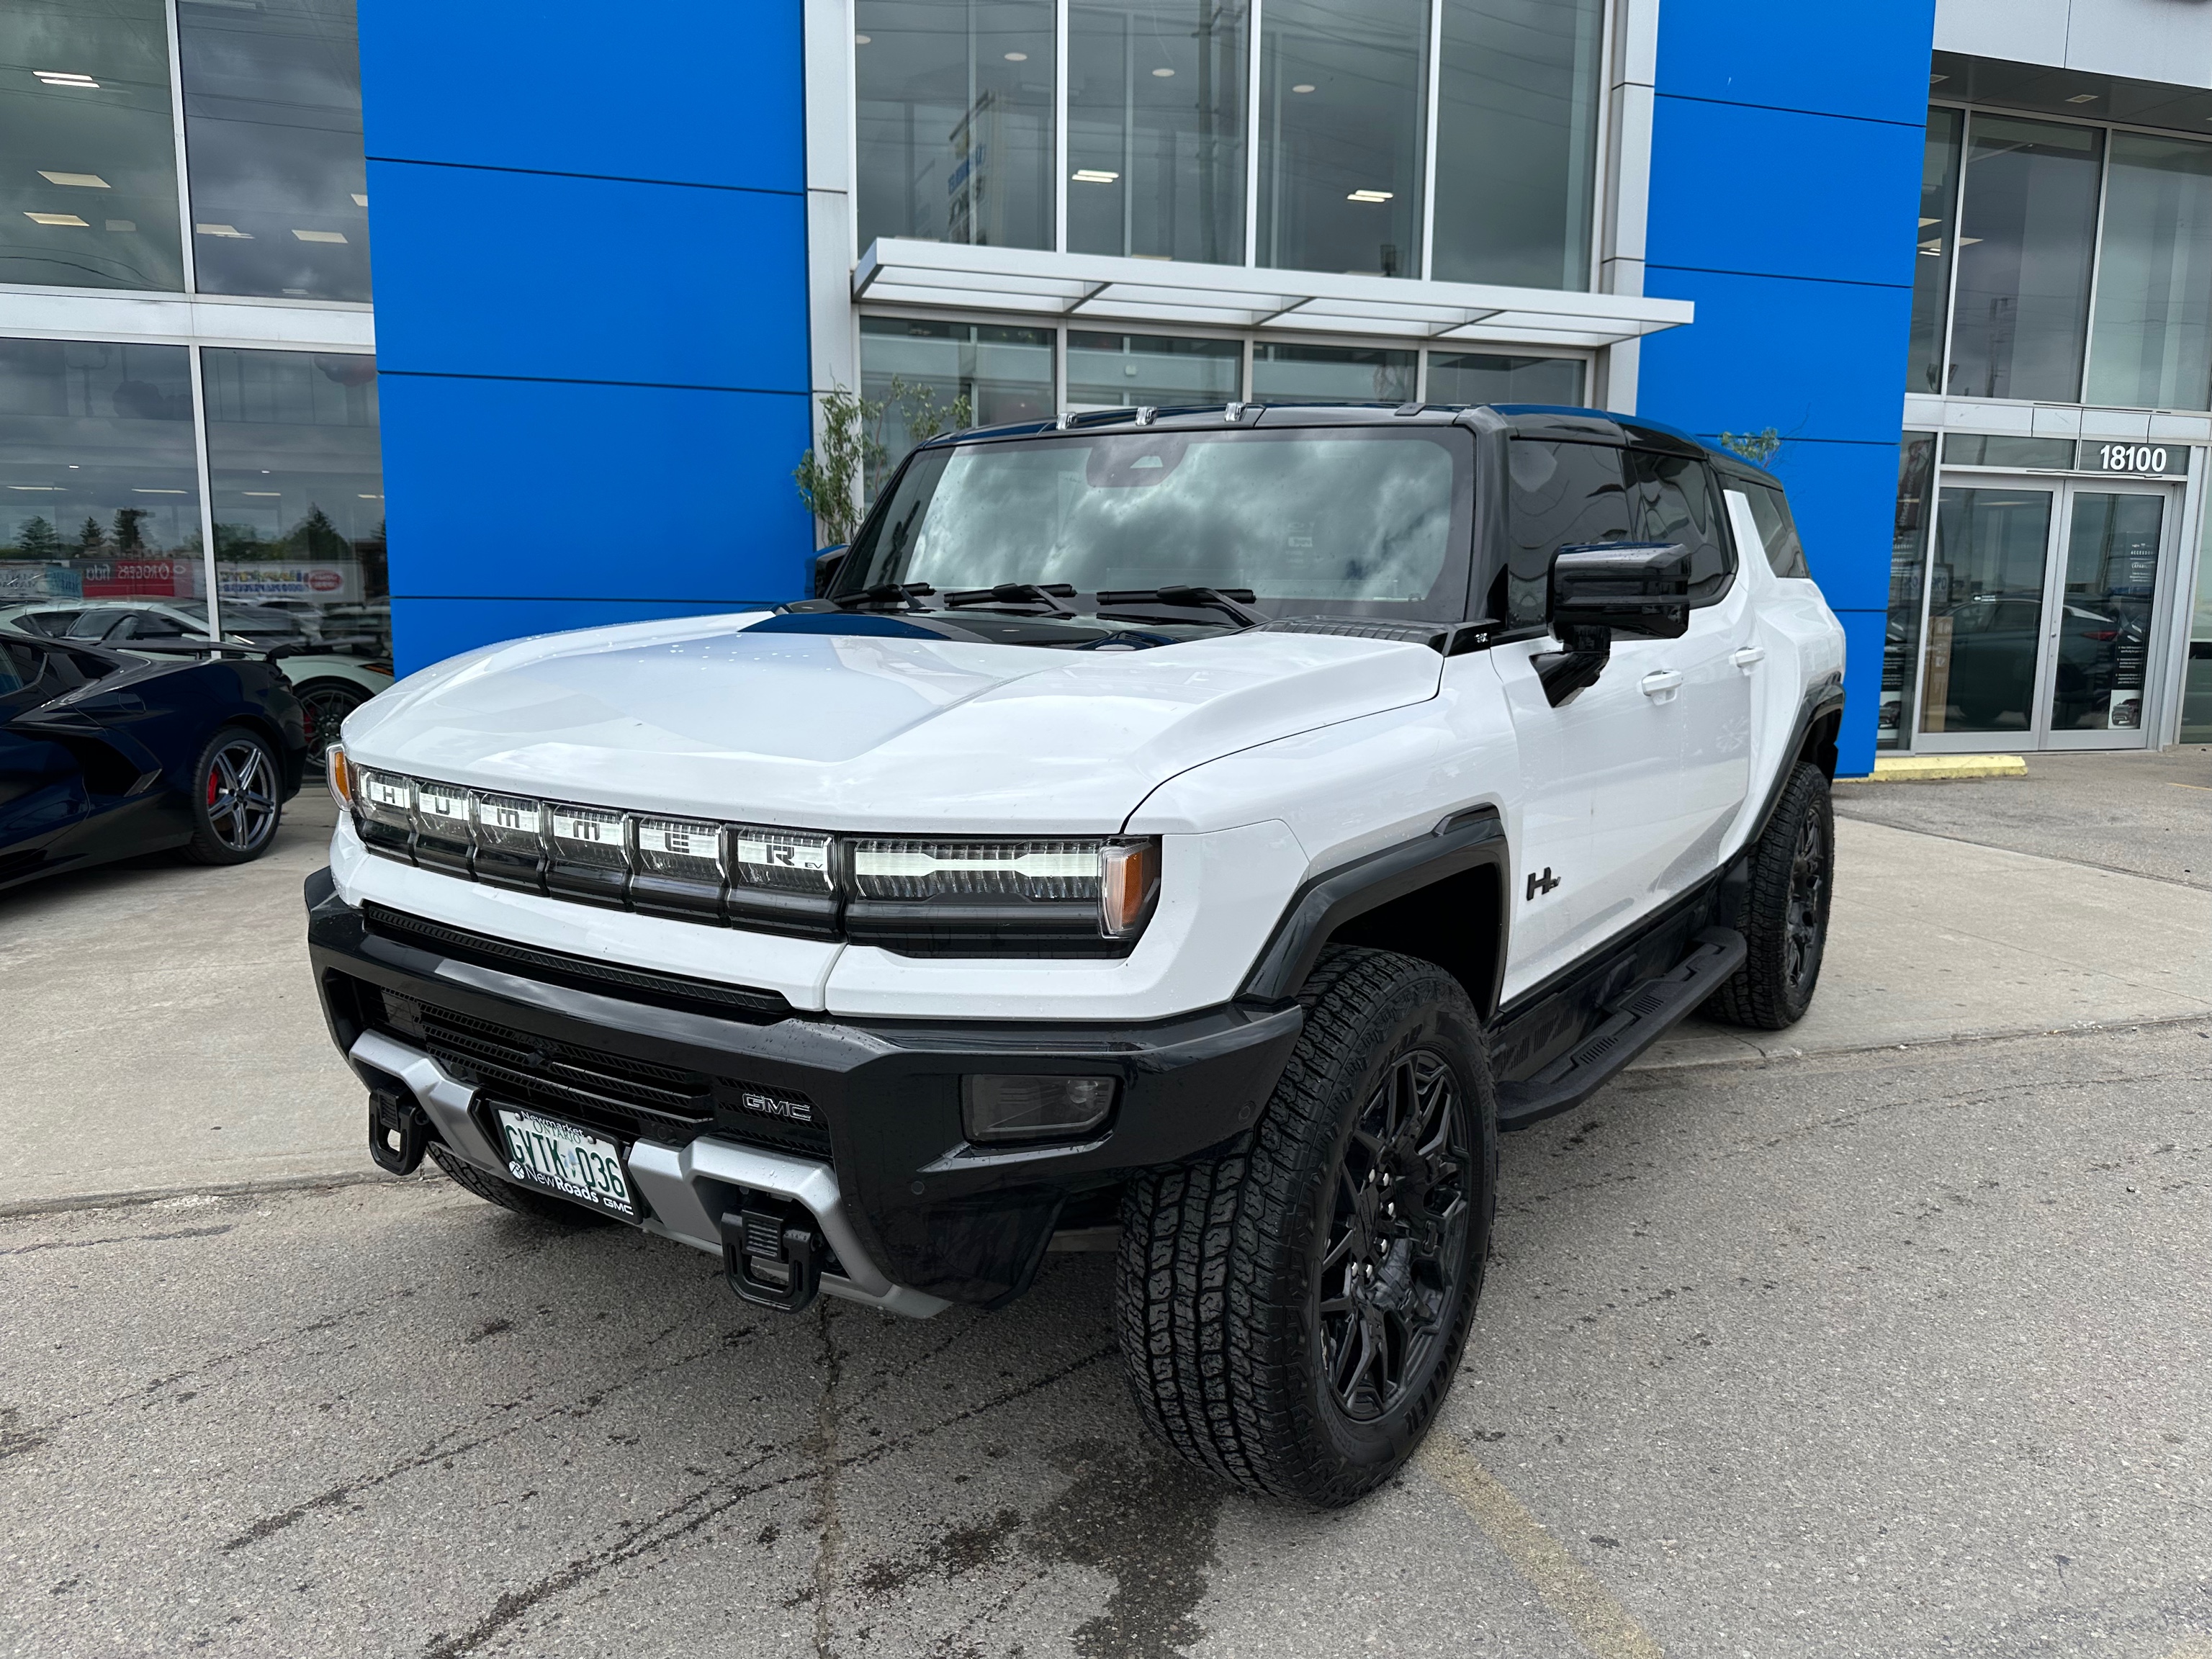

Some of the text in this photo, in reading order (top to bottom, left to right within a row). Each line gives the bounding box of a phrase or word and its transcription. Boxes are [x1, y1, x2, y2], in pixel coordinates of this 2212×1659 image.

[2100, 445, 2167, 472] 18100
[382, 785, 795, 866] HUMMER
[742, 1092, 812, 1121] GMC
[521, 1111, 584, 1137] Newmarket
[533, 1120, 581, 1144] ONTARIO
[505, 1125, 568, 1179] GVTK
[603, 1197, 634, 1215] GMC
[1403, 1251, 1484, 1437] WRANGLER
